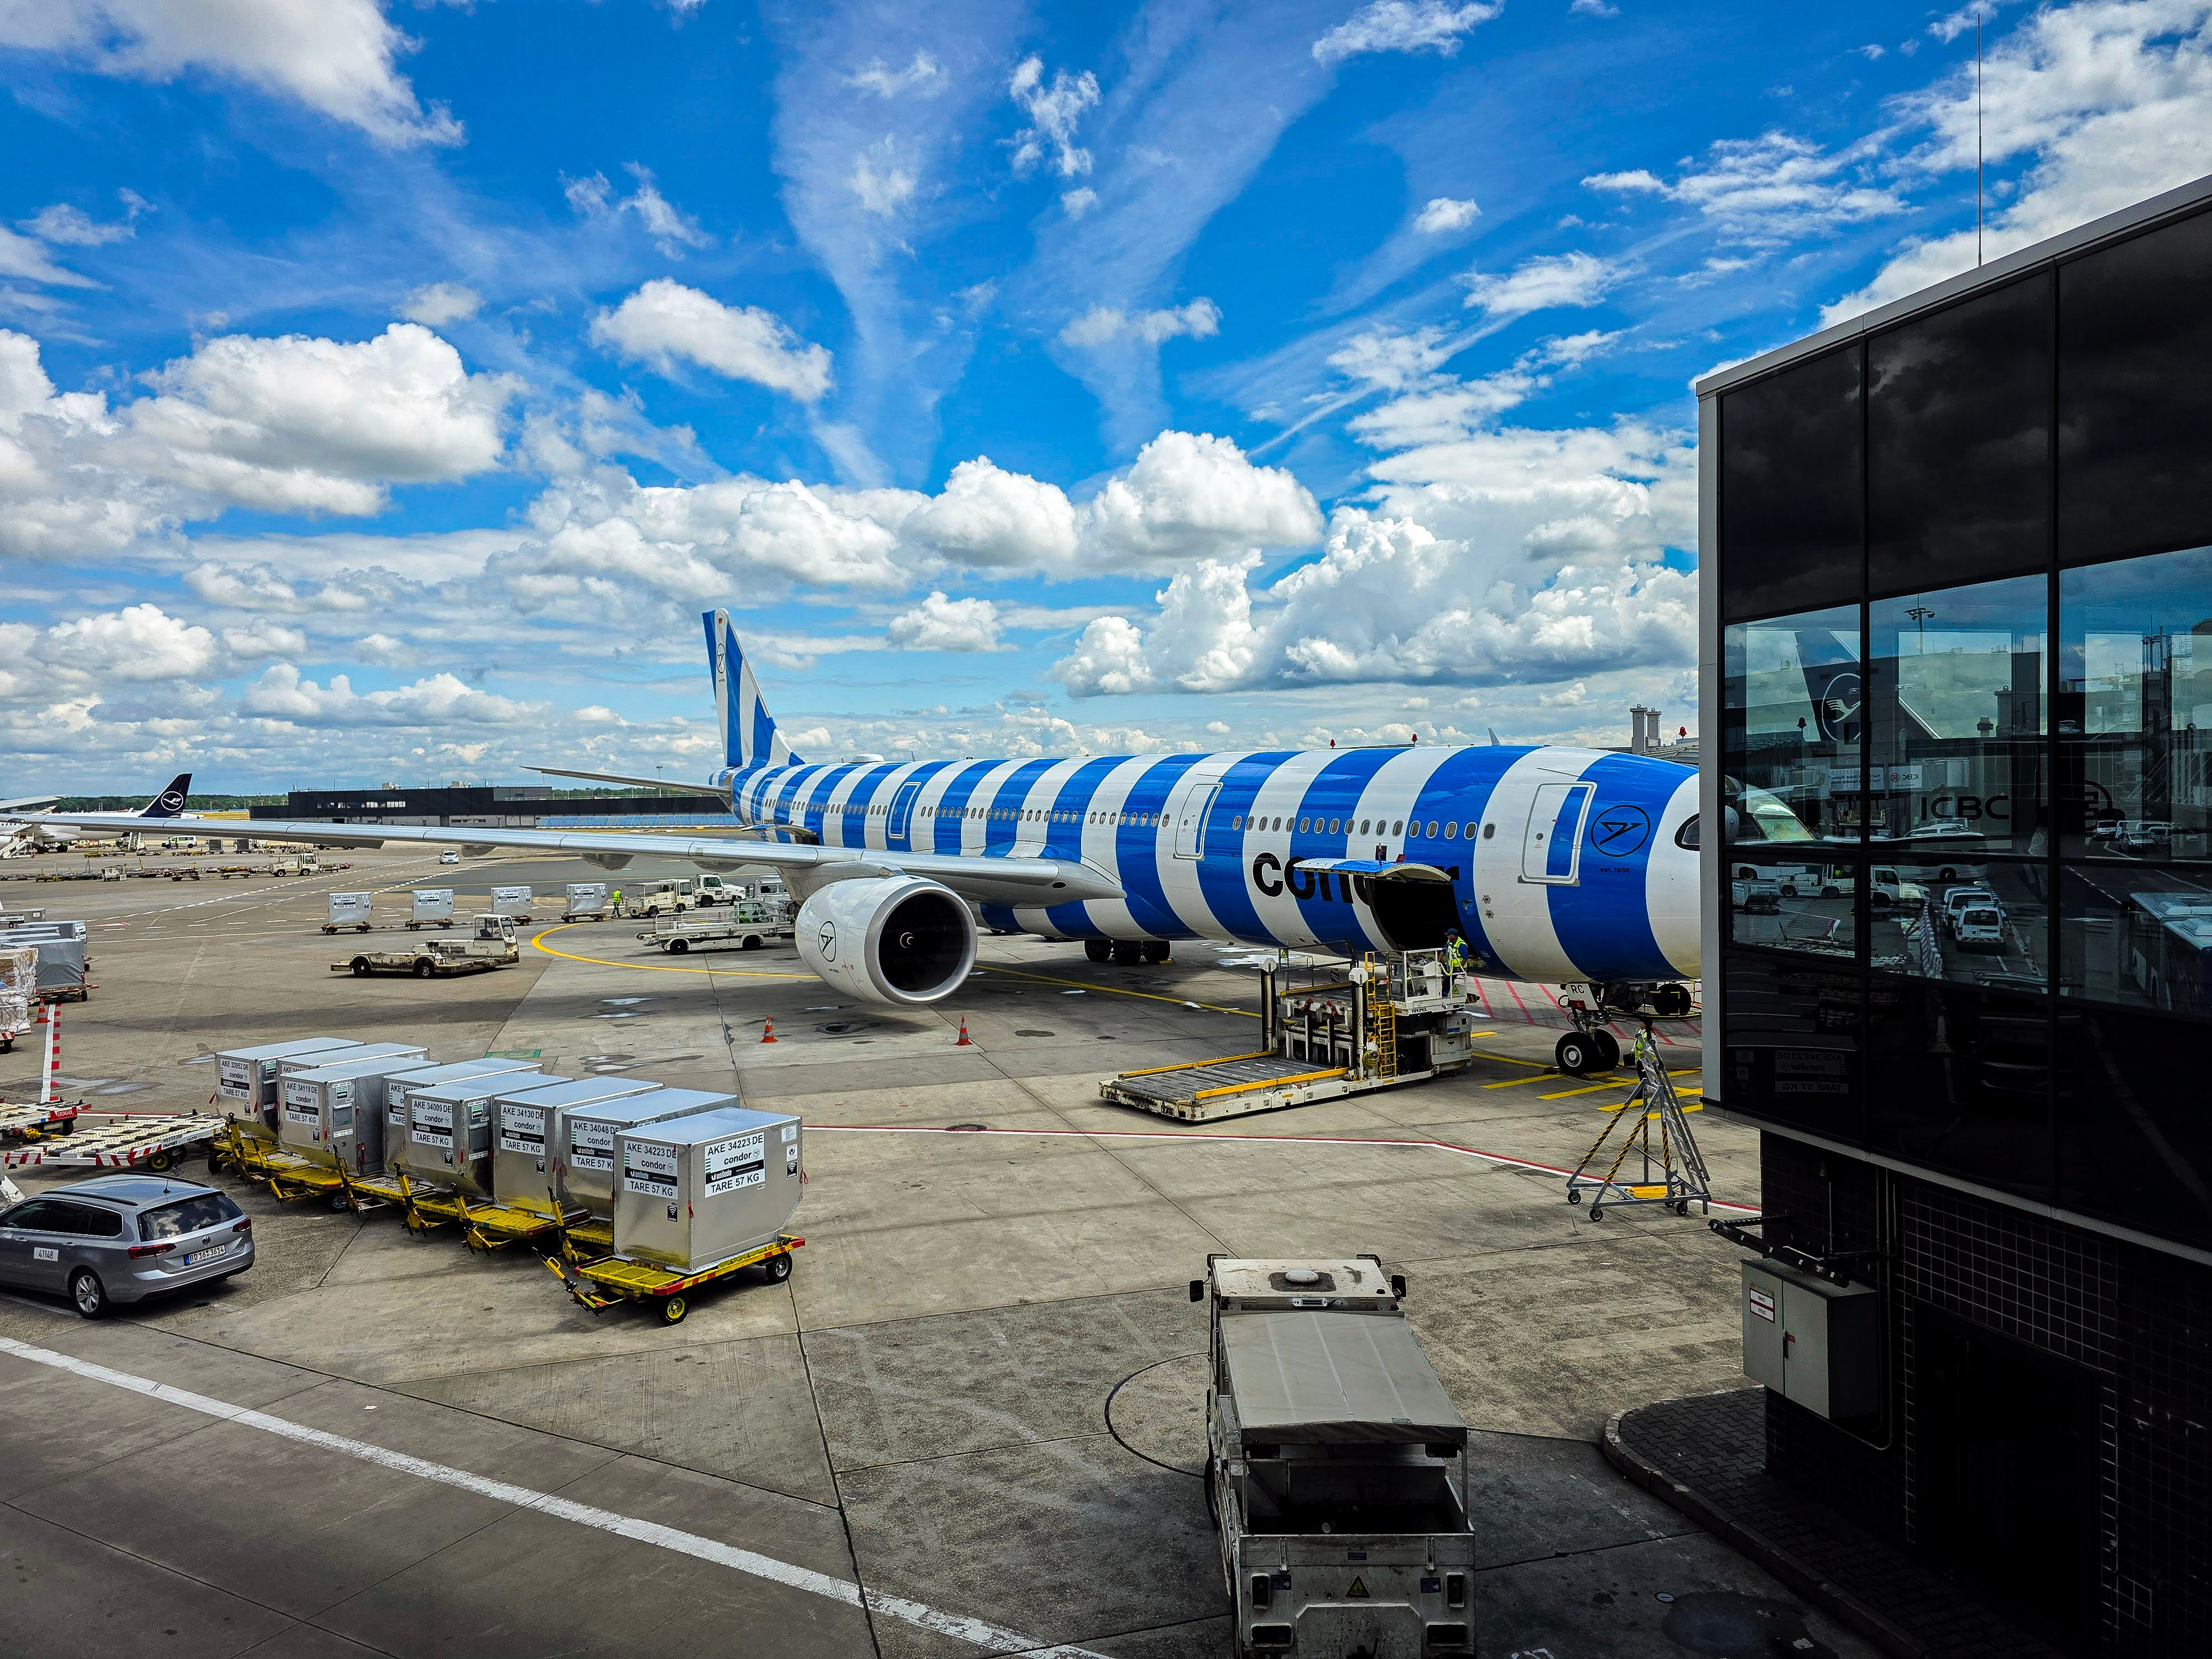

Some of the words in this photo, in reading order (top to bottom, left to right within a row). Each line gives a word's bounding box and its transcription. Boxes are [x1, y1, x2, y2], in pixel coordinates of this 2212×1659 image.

[1921, 795, 2009, 821] ICBC
[1571, 985, 1585, 994] RC
[223, 1088, 234, 1096] TARE
[287, 1082, 296, 1091] AKE
[298, 1084, 311, 1093] 34119
[390, 1084, 401, 1092] AKE
[414, 1100, 426, 1109] AKE
[427, 1102, 443, 1112] 34009
[443, 1105, 452, 1113] DE
[503, 1107, 516, 1115] AKE
[517, 1109, 534, 1118] 34130
[289, 1113, 301, 1121] TARE
[392, 1115, 405, 1124] TARE
[424, 1114, 444, 1124] condor
[514, 1121, 536, 1130] condor
[573, 1121, 588, 1131] AKE
[589, 1124, 609, 1134] 34048
[416, 1133, 431, 1143] TARE
[432, 1135, 439, 1144] 57
[440, 1137, 449, 1146] KG
[587, 1137, 611, 1146] condor
[708, 1144, 726, 1156] AKE
[728, 1138, 751, 1151] 34223
[752, 1134, 763, 1145] DE
[505, 1140, 521, 1150] TARE
[522, 1143, 529, 1151] 57
[531, 1145, 541, 1153] KG
[627, 1142, 642, 1153] AKE
[644, 1145, 665, 1157] 34223
[576, 1156, 596, 1167] TARE
[597, 1159, 605, 1168] 57
[607, 1161, 613, 1170] K
[724, 1151, 752, 1165] condor
[641, 1160, 666, 1170] condor
[630, 1181, 650, 1192] TARE
[652, 1185, 660, 1194] 57
[662, 1187, 673, 1196] KG
[711, 1180, 733, 1193] TARE
[735, 1177, 744, 1187] 57
[747, 1173, 759, 1184] KG
[39, 1249, 53, 1259] 41148
[190, 1253, 198, 1261] BD
[199, 1251, 206, 1259] 16
[210, 1246, 224, 1256] 3614
